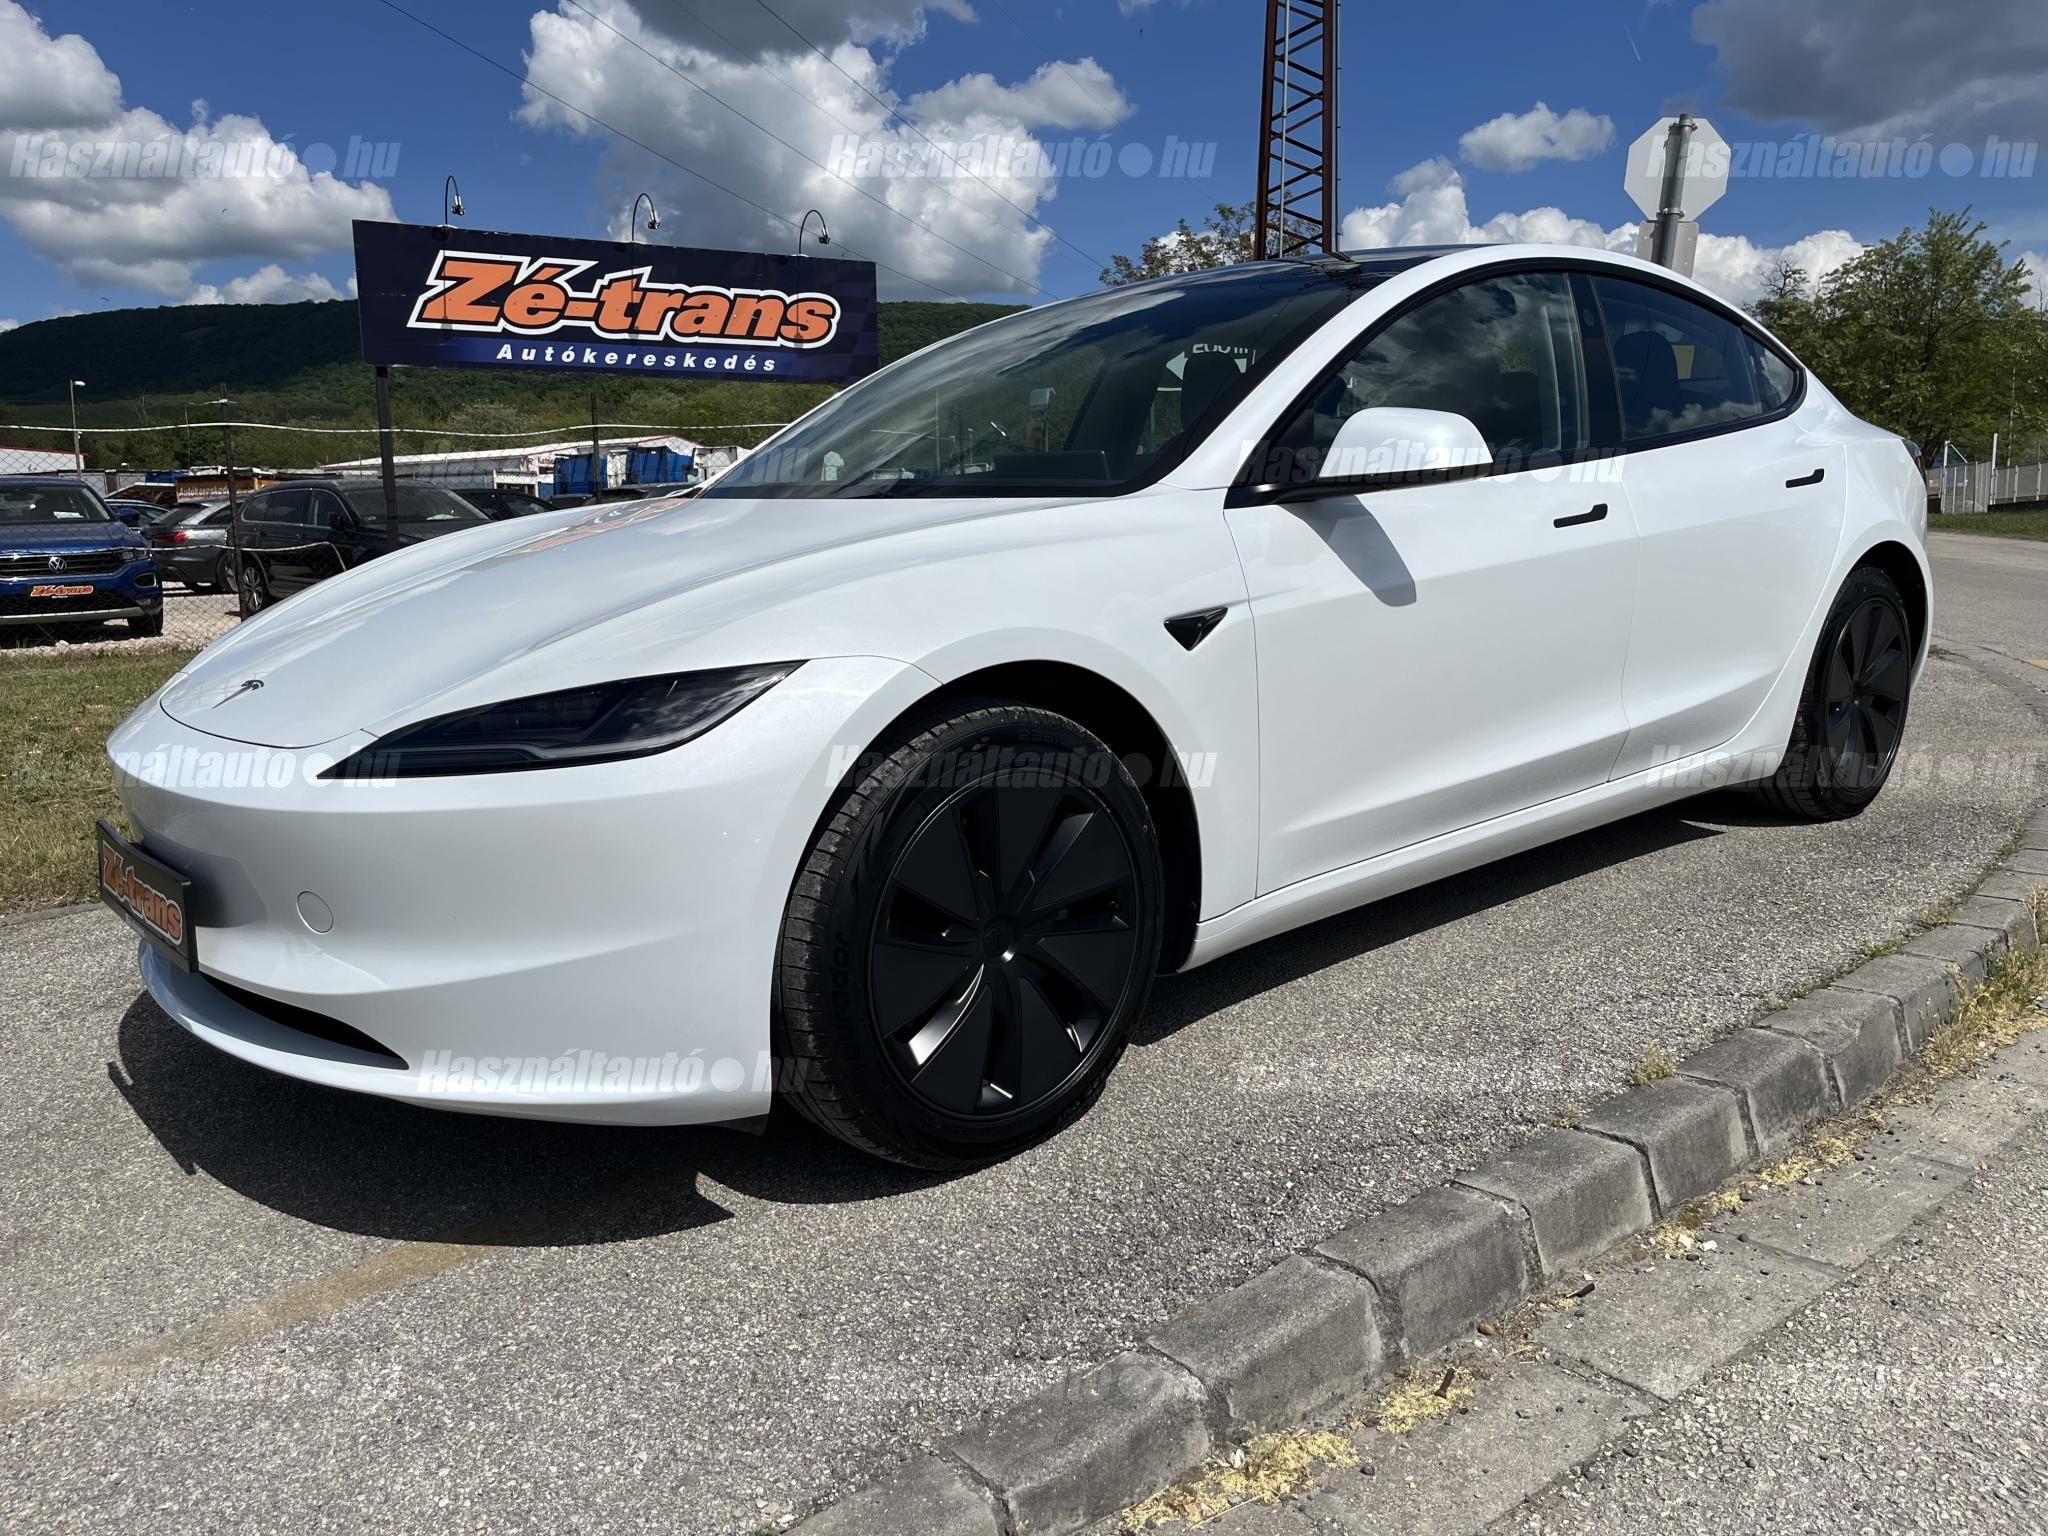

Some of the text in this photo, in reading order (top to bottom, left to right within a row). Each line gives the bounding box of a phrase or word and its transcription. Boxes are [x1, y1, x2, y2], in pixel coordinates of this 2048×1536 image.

[407, 250, 840, 347] Zé-trans
[497, 343, 777, 372] Autókereskedés
[103, 840, 182, 945] Zé-trans
